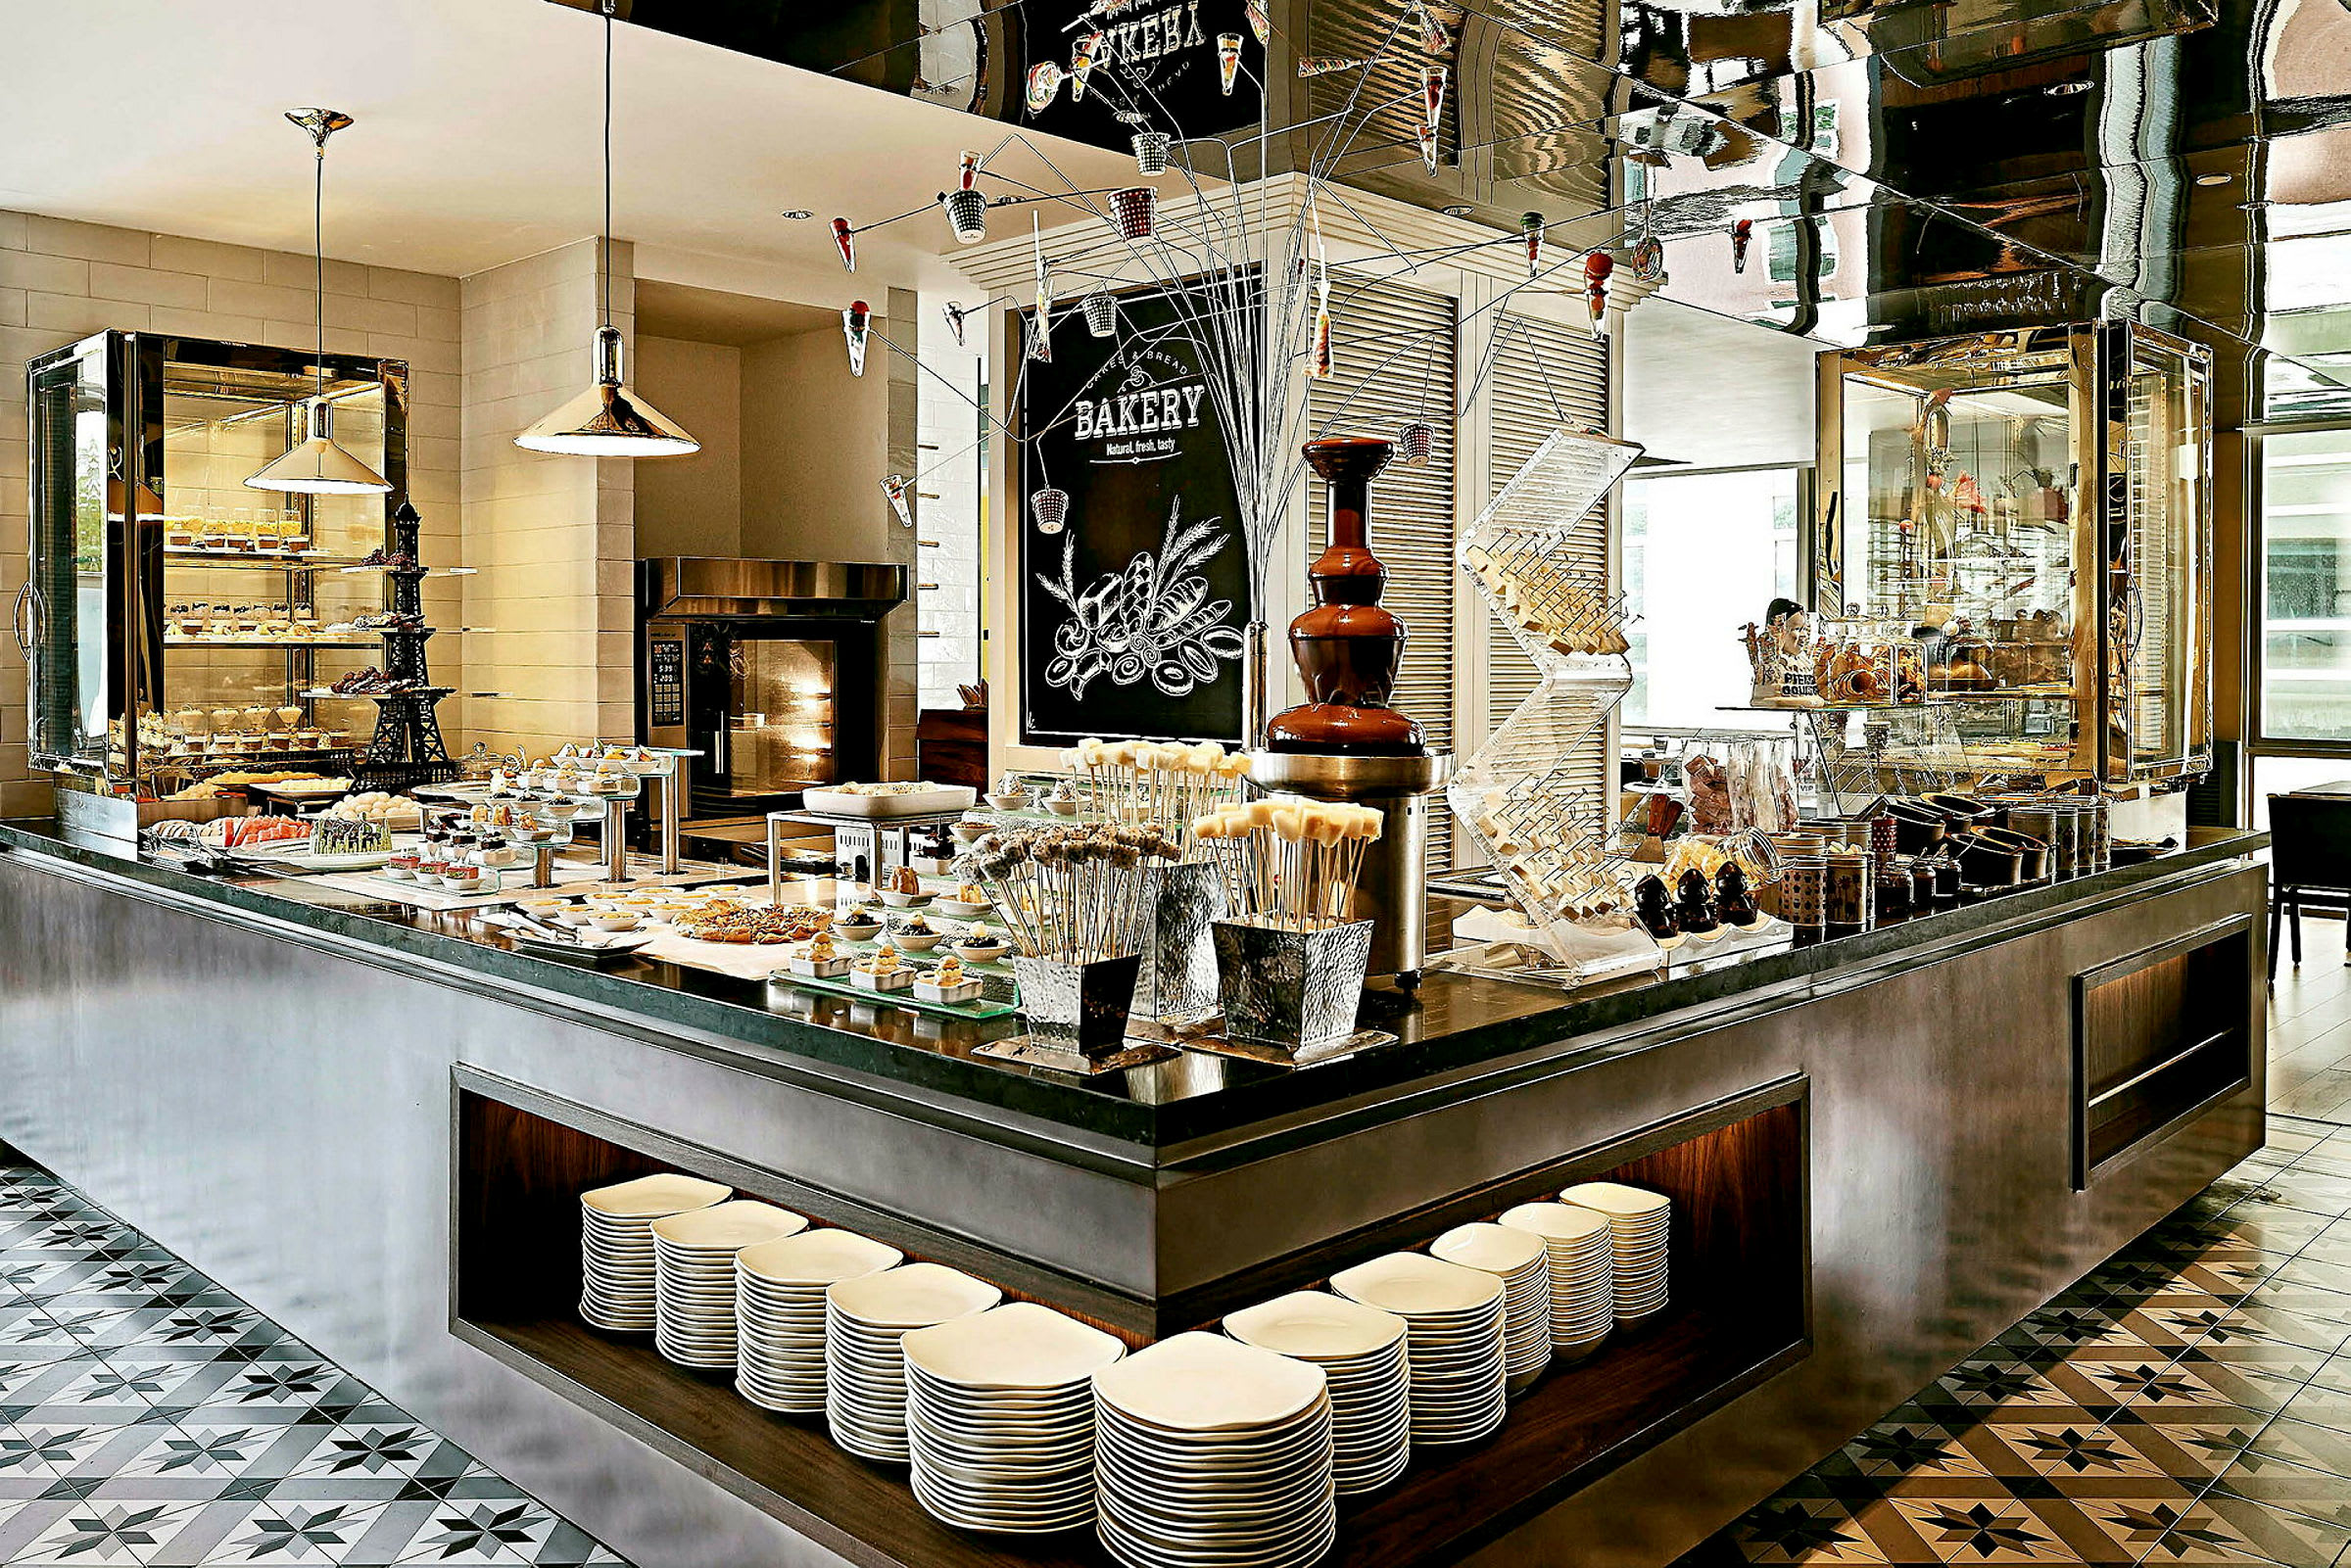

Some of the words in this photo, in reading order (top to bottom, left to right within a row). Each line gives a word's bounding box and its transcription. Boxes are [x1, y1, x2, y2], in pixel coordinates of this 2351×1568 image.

[1147, 351, 1188, 375] BREAD
[1075, 385, 1205, 441] BAKERY
[1158, 438, 1176, 451] tasty
